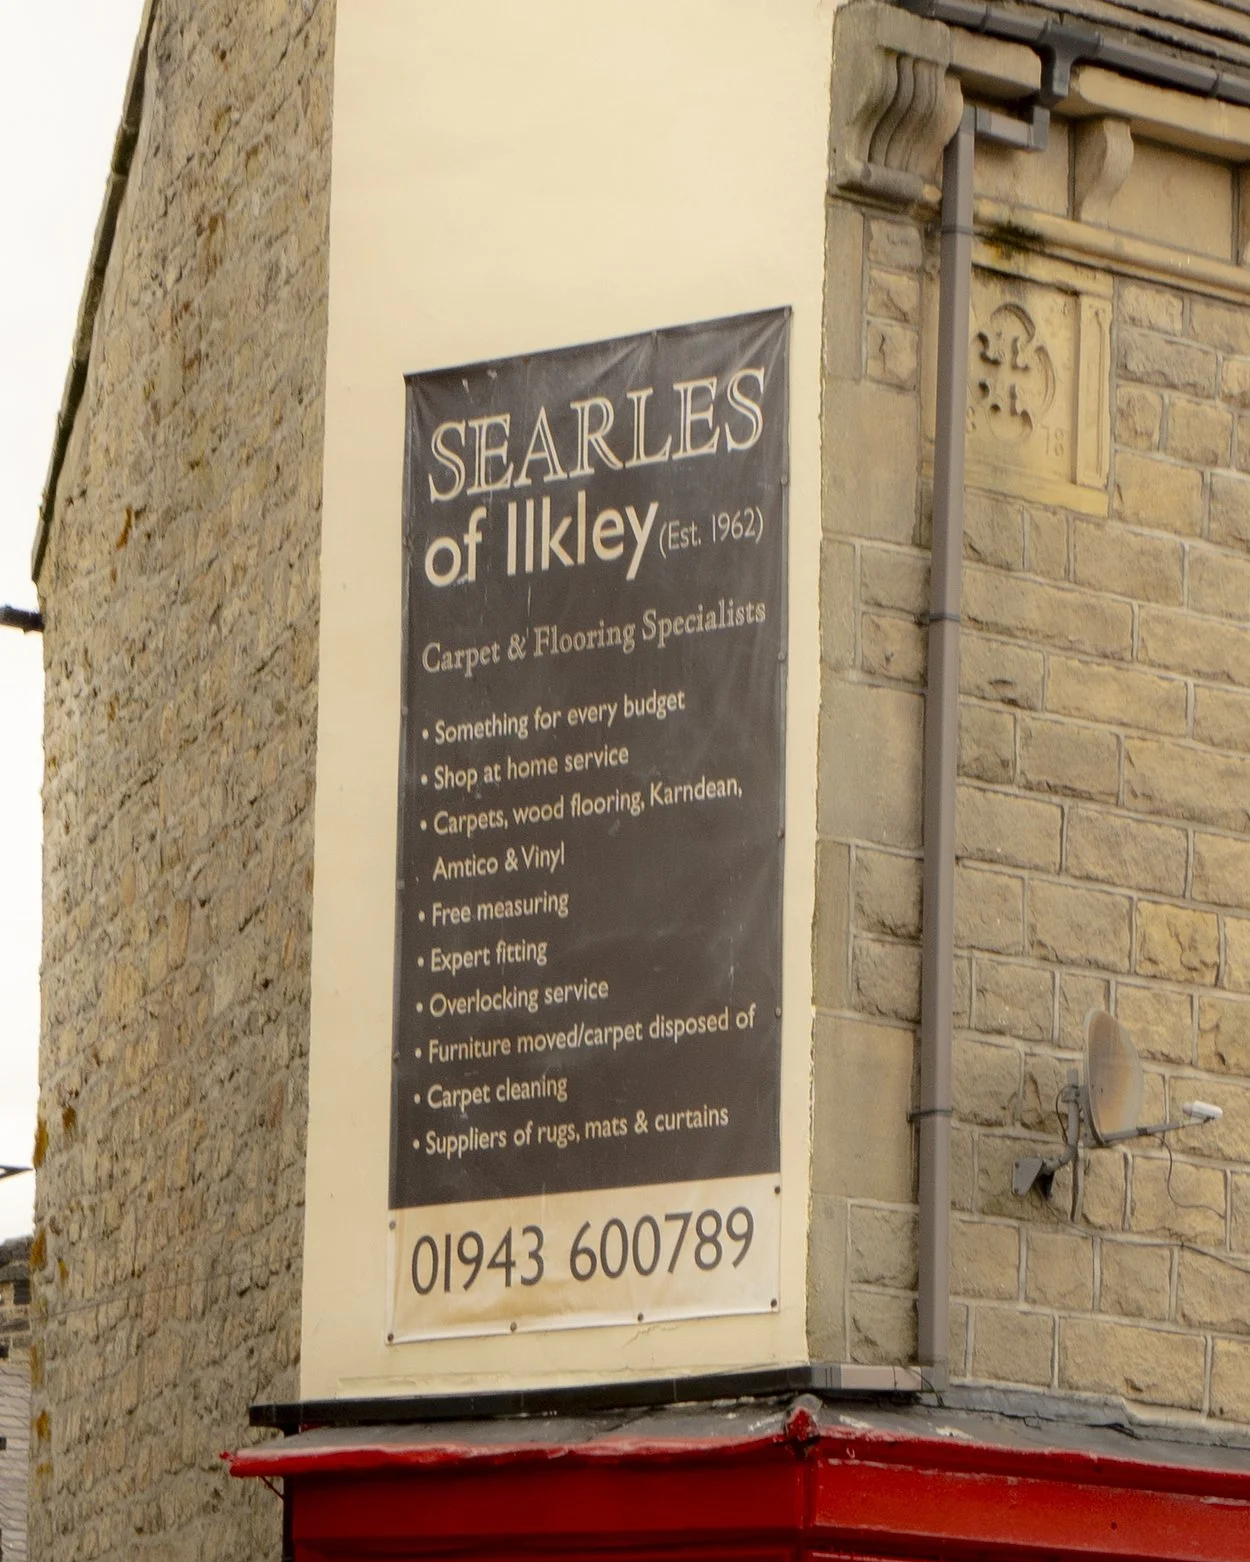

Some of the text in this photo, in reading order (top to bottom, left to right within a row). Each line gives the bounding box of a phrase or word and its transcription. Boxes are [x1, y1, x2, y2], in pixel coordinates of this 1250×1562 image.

[428, 366, 765, 504] SEARLES
[425, 489, 764, 587] of Ilkley (Est. 1962)
[422, 600, 766, 677] Carpet & Flooring Specialists
[435, 689, 685, 745] Something for every budget
[434, 744, 629, 792] Shop at home service
[434, 776, 743, 838] Carpets, wood flooring, Karndean,
[433, 841, 565, 882] Amtico & Vinyl
[432, 890, 569, 927] Free measuring
[431, 939, 548, 976] Expert fitting
[430, 978, 609, 1018] Overlocking service
[429, 1003, 756, 1063] Furniture moved/carpet disposed of
[427, 1075, 568, 1112] Carpet cleaning
[425, 1104, 729, 1160] Suppliers of rugs, mats & curtains
[411, 1206, 755, 1296] 01943 600789
